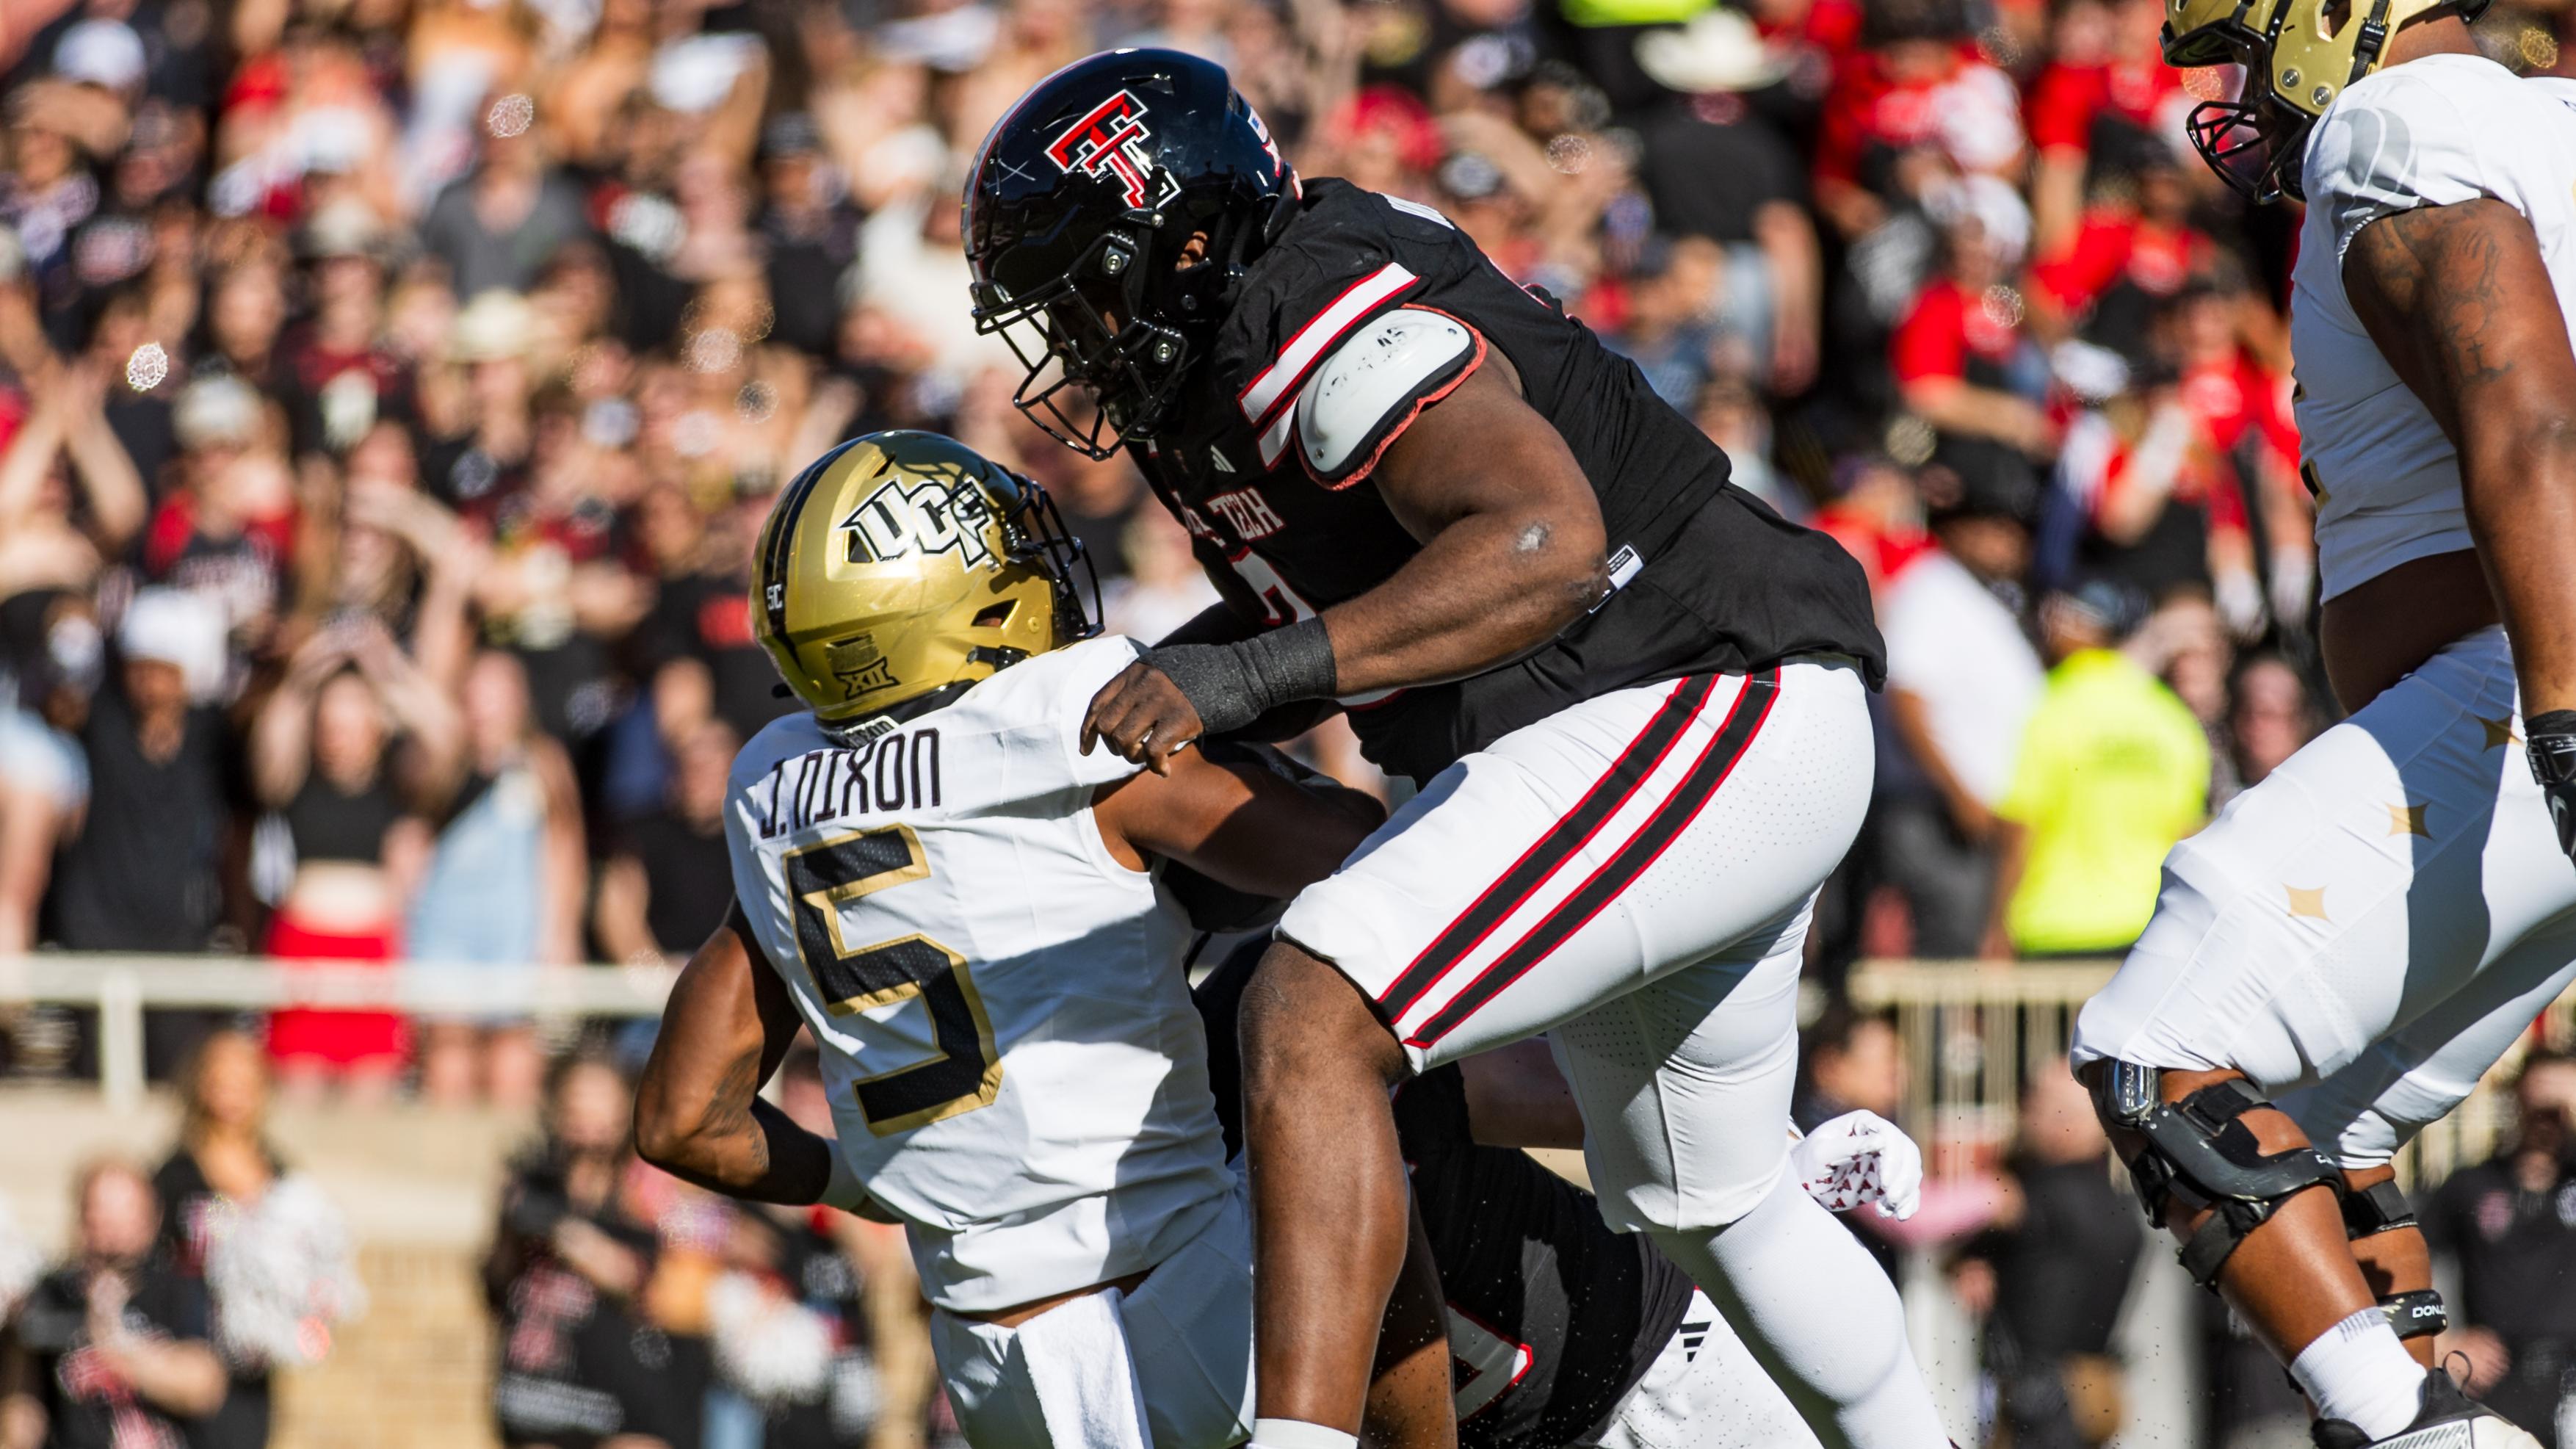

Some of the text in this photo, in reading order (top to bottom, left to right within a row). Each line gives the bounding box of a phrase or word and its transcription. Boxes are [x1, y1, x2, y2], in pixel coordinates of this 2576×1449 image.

[837, 476, 994, 573] UCF
[1204, 486, 1286, 543] TECH
[834, 656, 901, 700] XII
[782, 823, 1004, 1138] 5
[2412, 1304, 2446, 1318] DONJ
